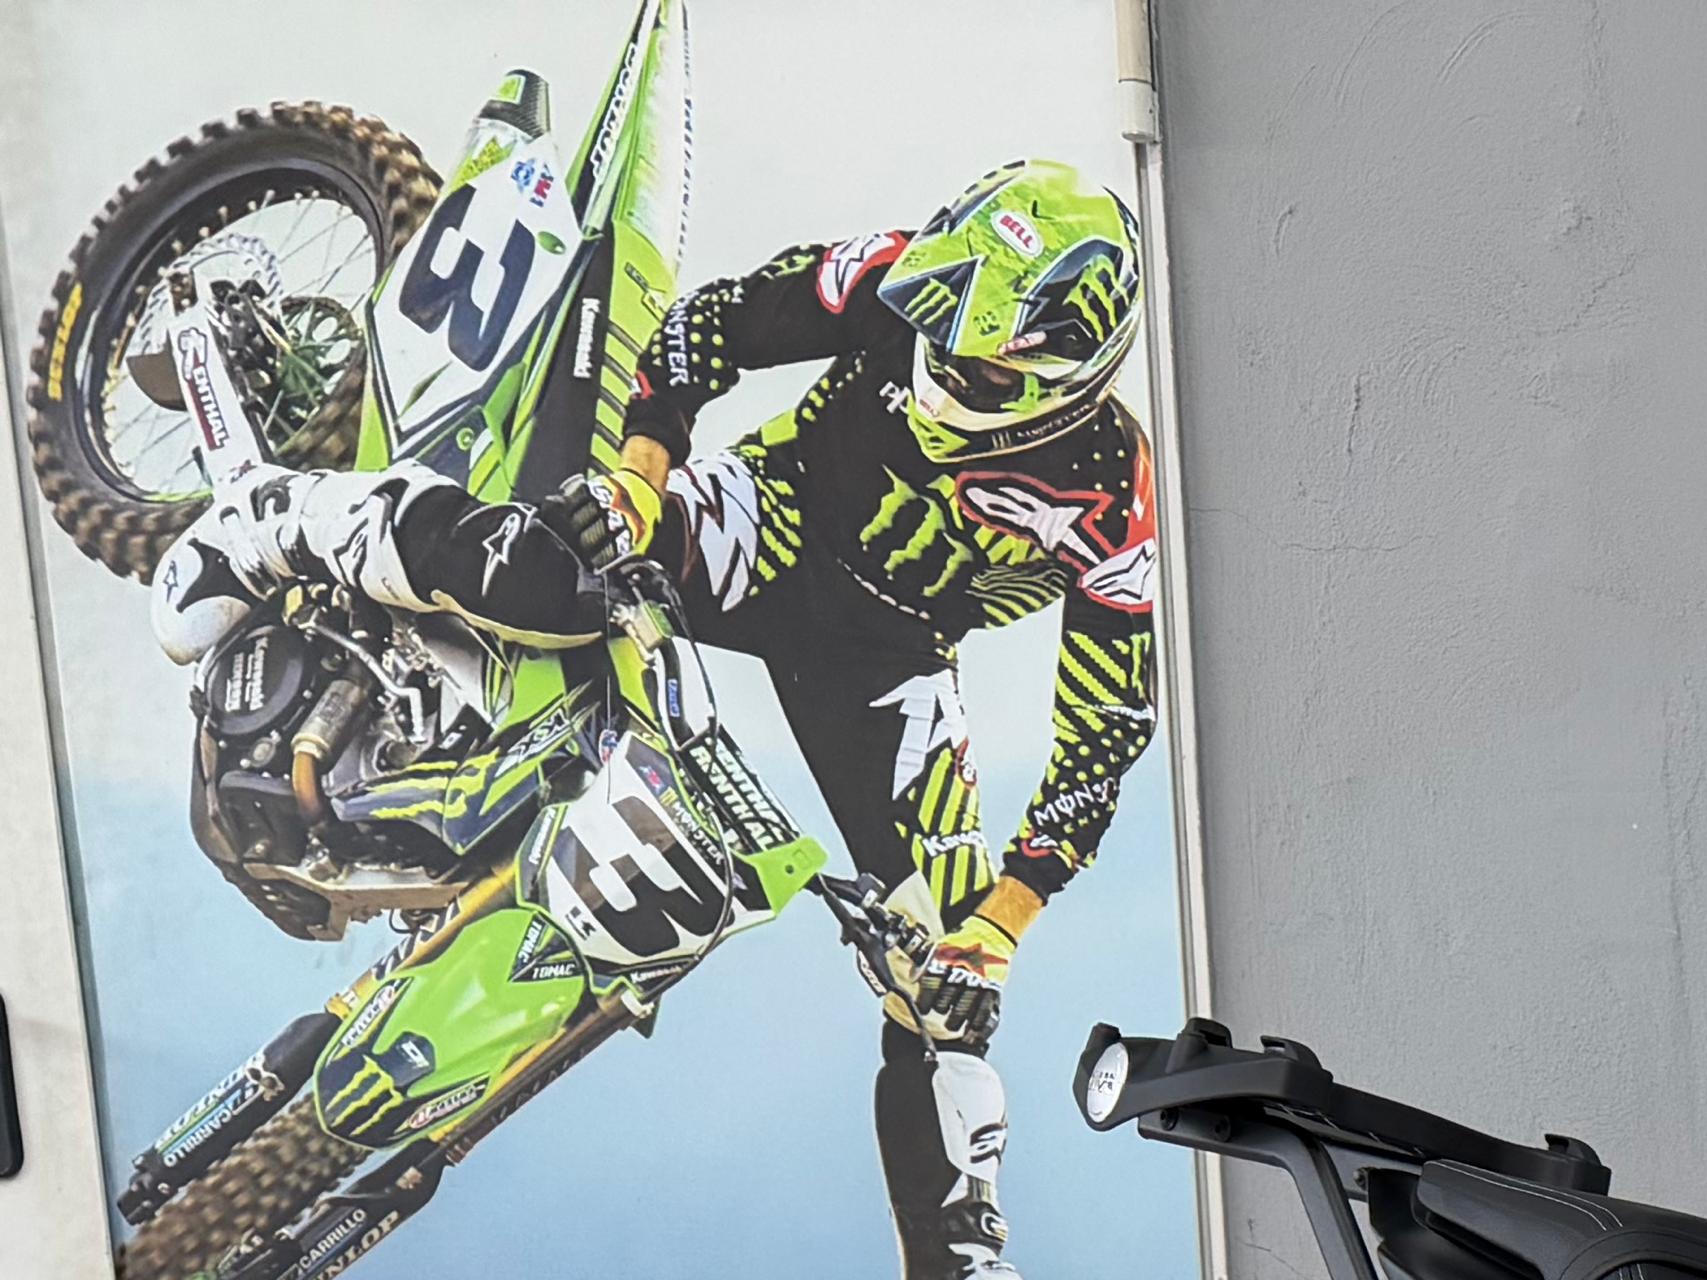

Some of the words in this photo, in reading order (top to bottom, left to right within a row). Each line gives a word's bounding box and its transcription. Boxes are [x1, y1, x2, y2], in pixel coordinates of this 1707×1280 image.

[999, 214, 1035, 249] BELL
[398, 183, 536, 372] 3
[573, 297, 600, 379] Kawasaki
[177, 326, 230, 451] RENTHAL
[551, 796, 736, 957] 3
[163, 1109, 234, 1168] CARRILLO
[299, 1208, 368, 1271] CARRILLO
